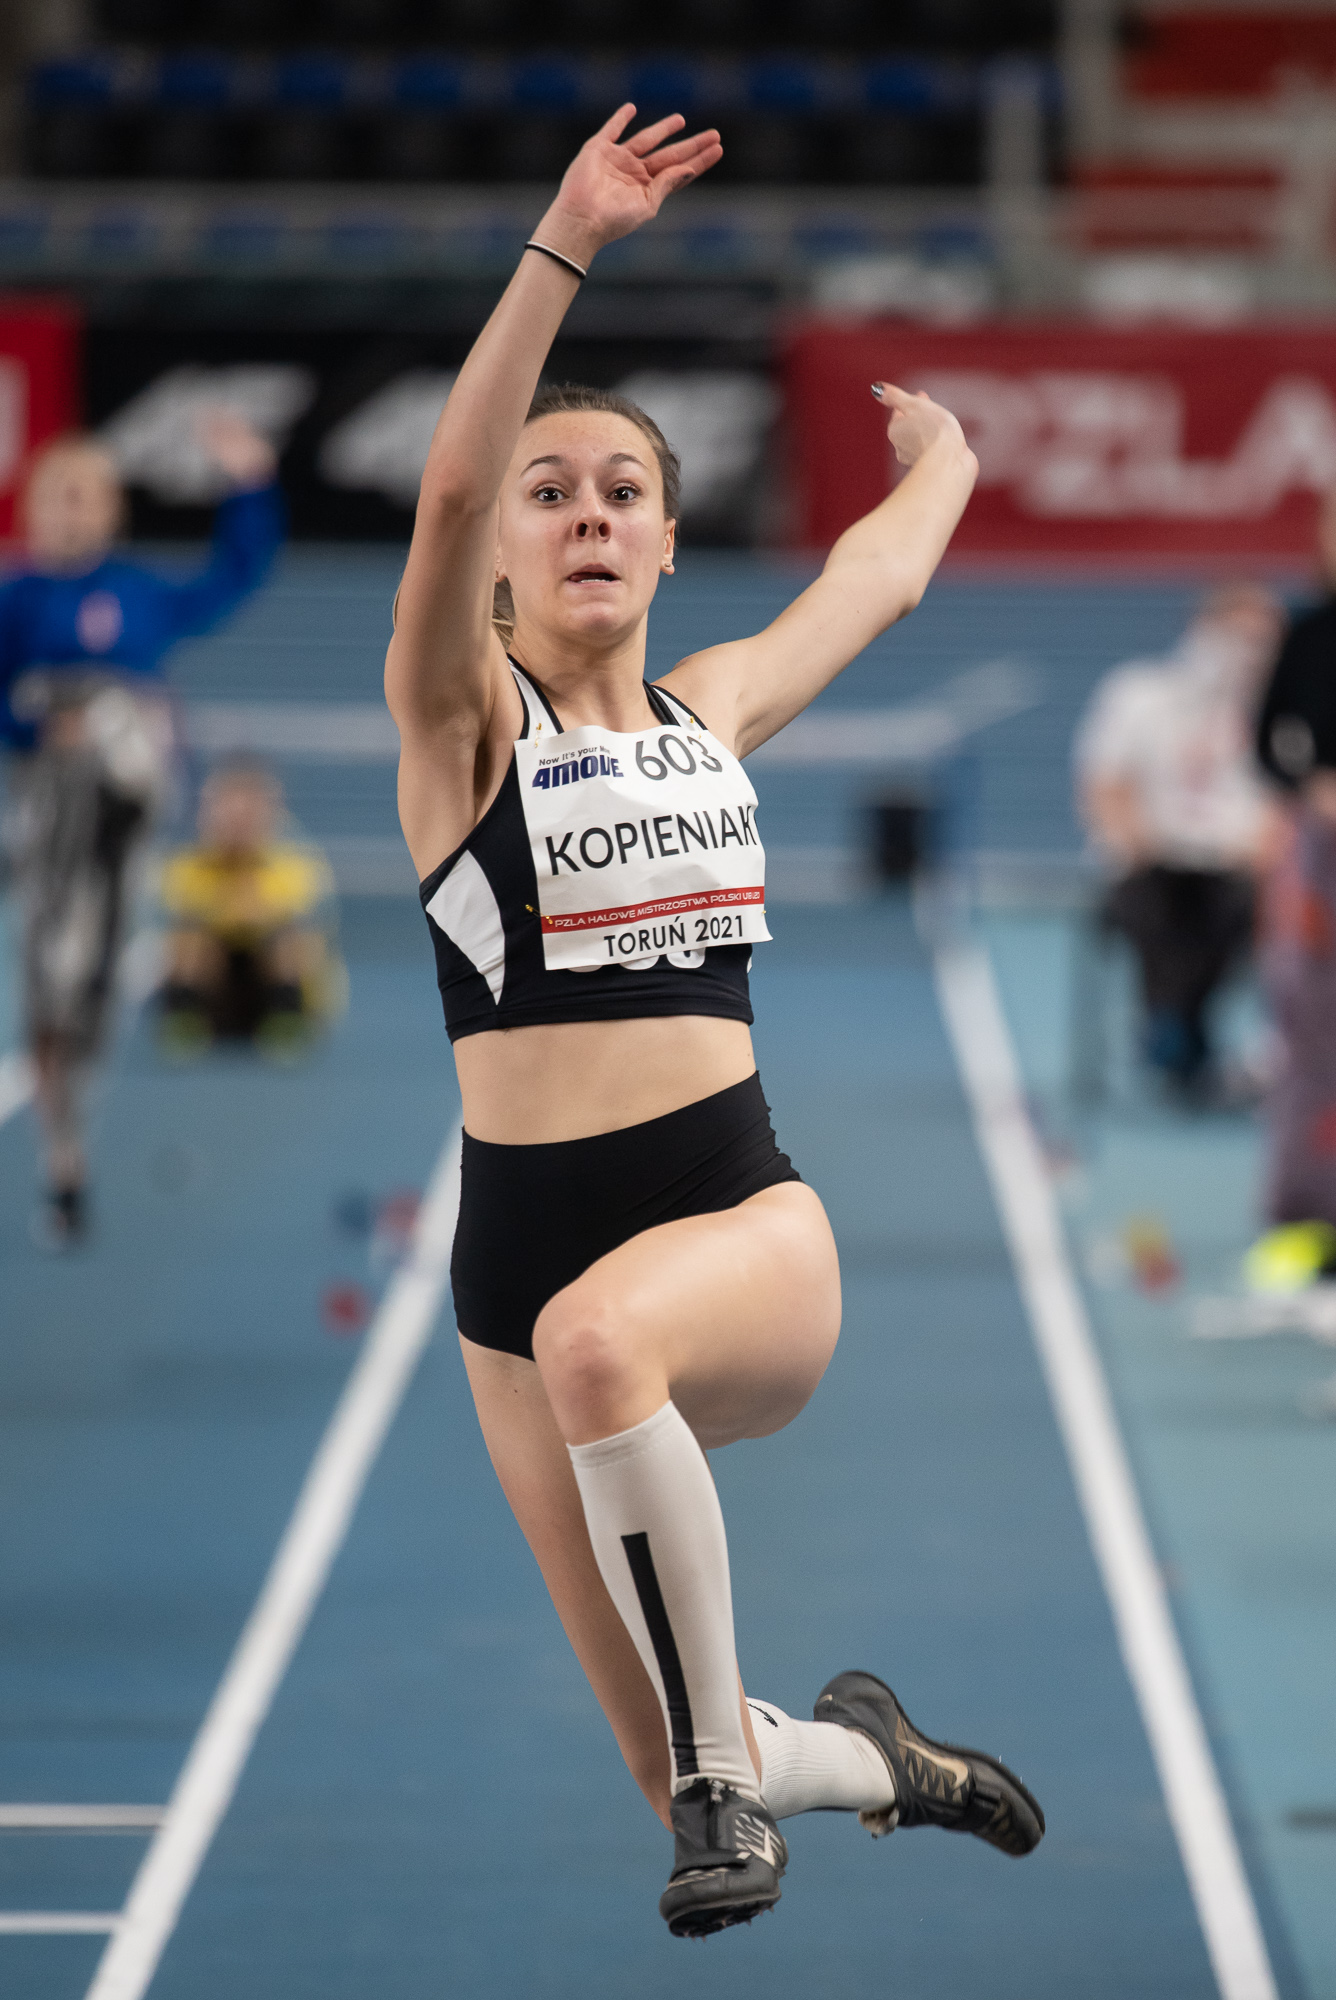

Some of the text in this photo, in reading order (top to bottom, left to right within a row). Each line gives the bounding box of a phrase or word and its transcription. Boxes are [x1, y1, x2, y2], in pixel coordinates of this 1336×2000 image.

[539, 756, 559, 766] Now
[577, 746, 598, 758] your
[635, 733, 723, 781] 603
[545, 805, 758, 876] KOPIENIAK
[554, 918, 586, 927] PZLA
[588, 909, 636, 924] HALOWE
[637, 897, 709, 917] MISTRZOSTWA
[710, 892, 742, 904] POLSKI
[604, 914, 744, 957] TORUŃ 2021
